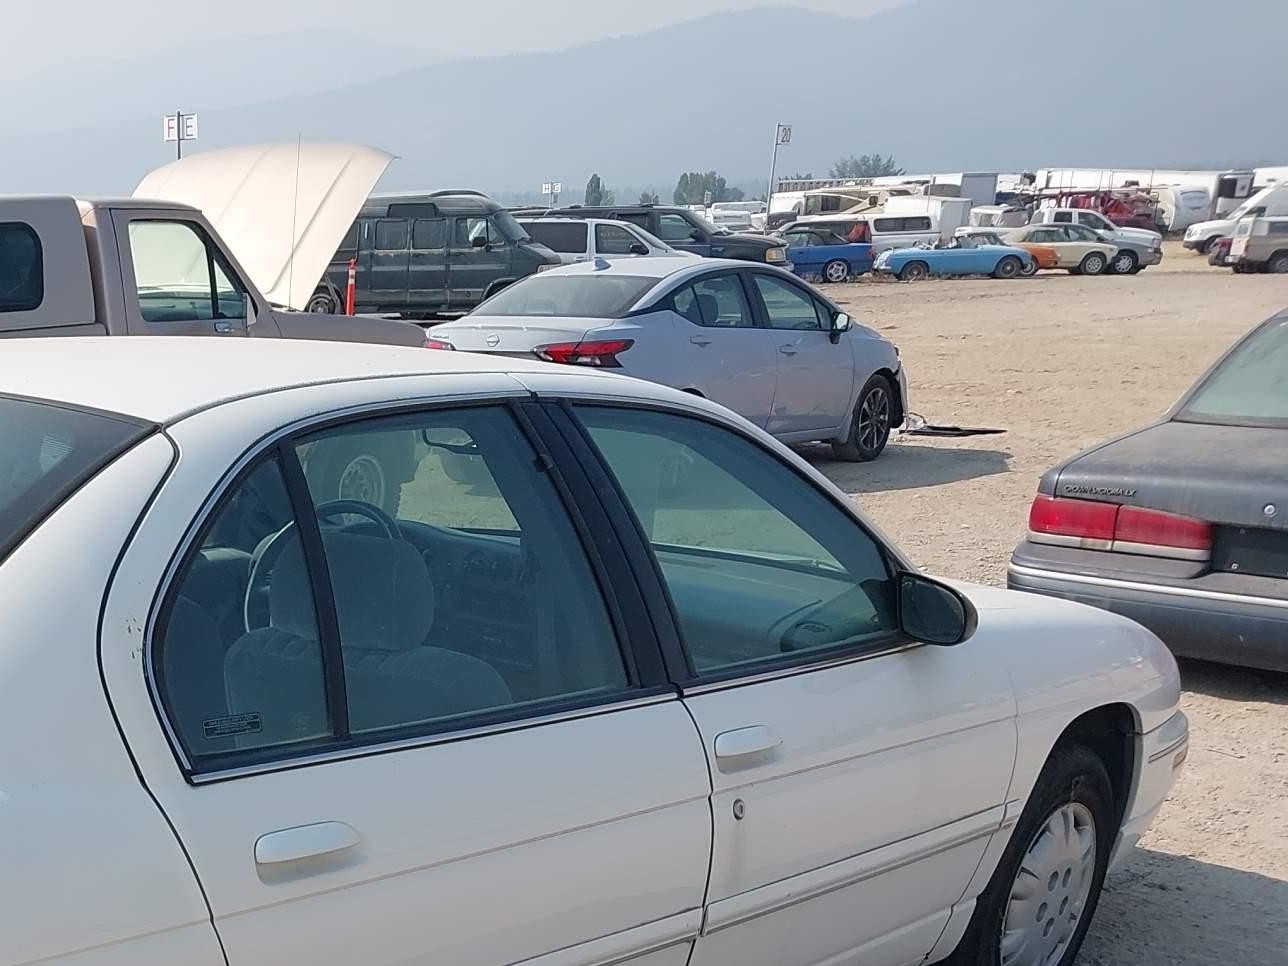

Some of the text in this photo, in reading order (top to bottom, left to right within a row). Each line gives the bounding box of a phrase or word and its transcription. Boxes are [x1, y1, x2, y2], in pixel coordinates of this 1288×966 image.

[167, 118, 176, 138] F
[185, 117, 194, 137] E
[781, 127, 792, 143] 20
